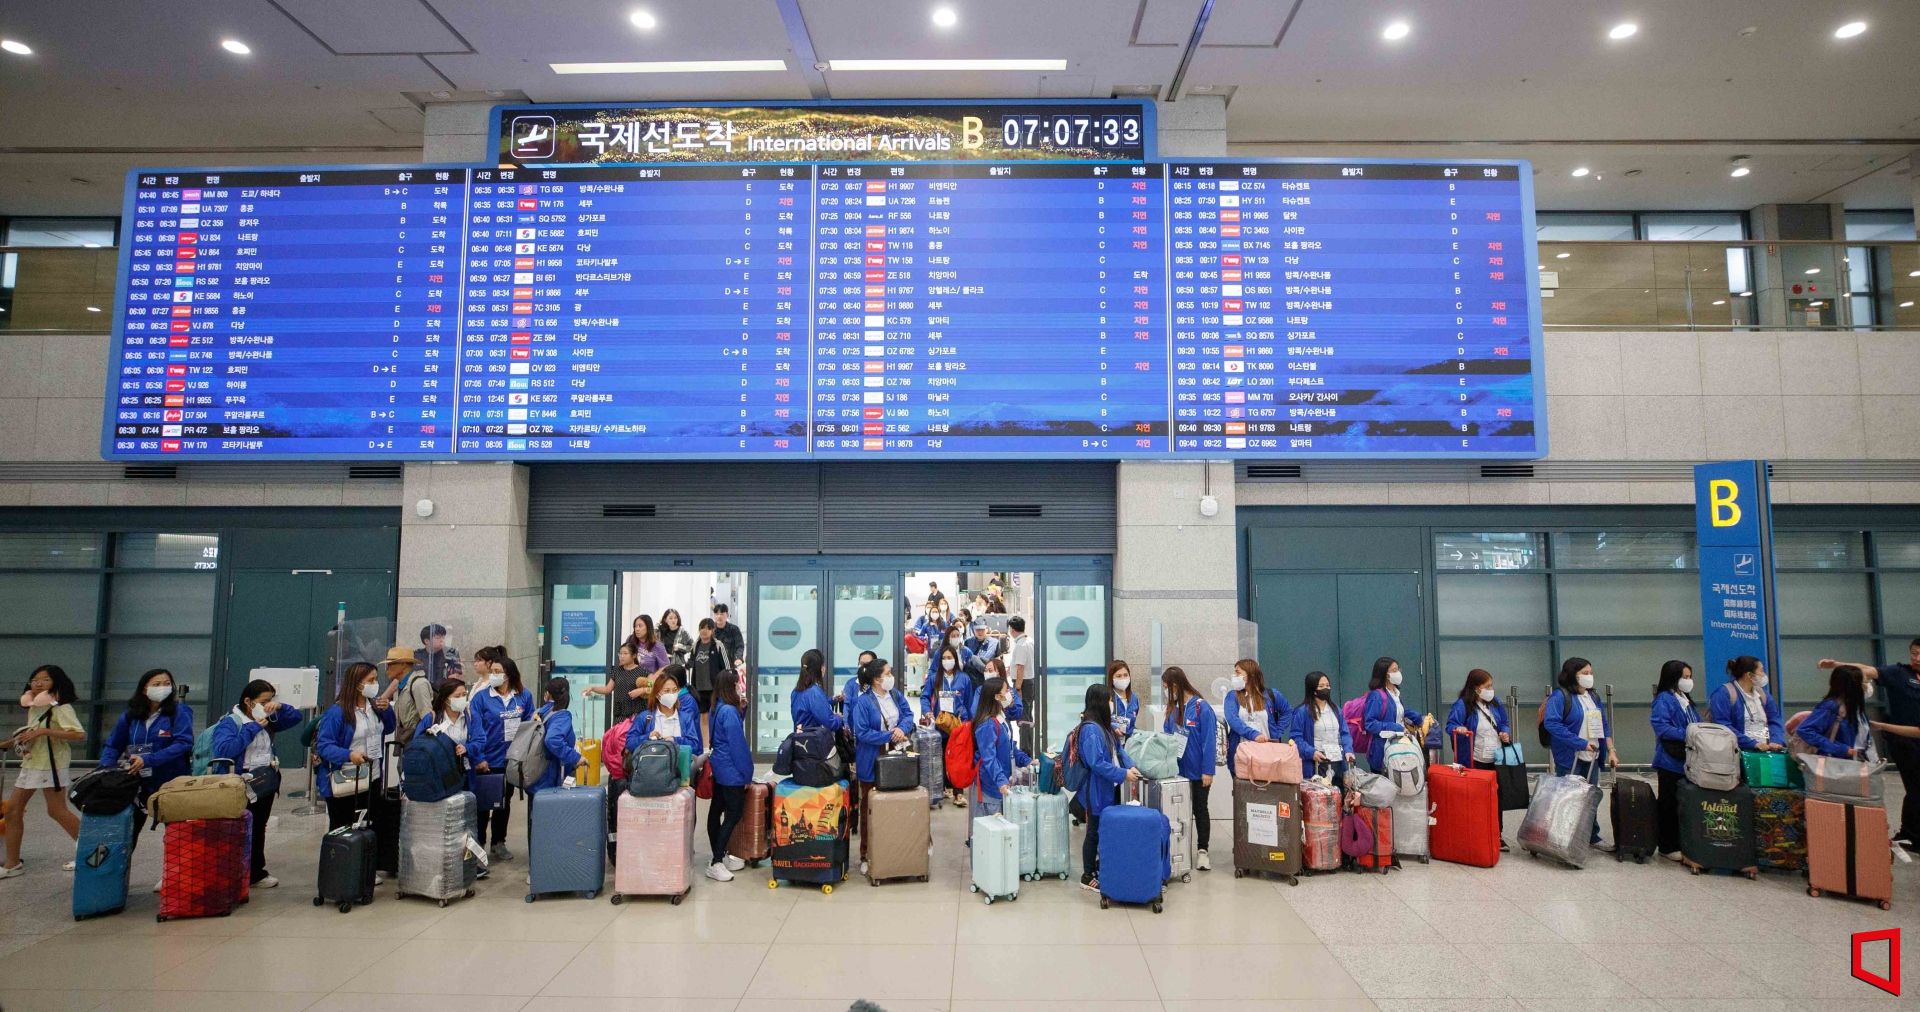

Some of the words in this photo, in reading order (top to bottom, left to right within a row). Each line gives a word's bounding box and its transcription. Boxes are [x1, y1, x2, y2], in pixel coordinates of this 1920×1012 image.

[577, 121, 736, 153] 국제선도착
[747, 134, 872, 152] International
[878, 134, 951, 152] Arrivals
[962, 116, 984, 150] B
[1004, 118, 1139, 146] 07:07:33
[476, 171, 492, 180] 시간
[542, 170, 557, 179] 편명
[639, 169, 661, 178] 출발지
[741, 168, 757, 177] 출구
[779, 168, 795, 177] 현황
[822, 167, 838, 176] 시간
[890, 167, 905, 176] 편명
[989, 166, 1011, 176] 출발지
[1093, 166, 1108, 176] 출구
[1131, 166, 1147, 176] 현황
[1174, 166, 1190, 176] 시간
[1242, 167, 1257, 176] 편명
[1341, 167, 1364, 176] 출발지
[1443, 168, 1459, 177] 출구
[1483, 168, 1498, 178] 현황
[142, 176, 157, 185] 시간
[206, 175, 220, 185] 편명
[299, 174, 321, 183] 출발지
[398, 172, 413, 182] 출구
[435, 172, 450, 181] 현황
[778, 182, 794, 191] 도착
[928, 182, 958, 191] 비엔티안
[1131, 181, 1147, 190] 지연
[1281, 182, 1310, 191] 타슈켄트
[260, 189, 281, 198] 하네다
[434, 186, 449, 195] 도착
[578, 199, 593, 208] 세부
[778, 197, 794, 206] 지연
[1282, 196, 1311, 206] 타슈켄트
[578, 214, 606, 223] 싱가포르
[928, 211, 951, 220] 나트랑
[1486, 212, 1501, 221] 지연
[928, 226, 950, 235] 하노이
[1283, 226, 1306, 235] 사이판
[237, 233, 259, 242] 나트랑
[576, 243, 592, 252] 다낭
[576, 258, 618, 267] 코타키나발루
[928, 256, 951, 265] 나트랑
[1284, 256, 1300, 265] 다낭
[235, 262, 263, 271] 치앙마이
[928, 270, 957, 280] 치앙마이
[1133, 270, 1149, 280] 도착
[232, 291, 254, 300] 하노이
[574, 288, 590, 297] 세부
[426, 304, 442, 313] 지연
[927, 301, 943, 310] 세부
[1491, 301, 1506, 310] 지연
[927, 316, 950, 325] 알마티
[1286, 316, 1309, 325] 나트랑
[230, 321, 246, 330] 다낭
[572, 333, 588, 342] 다낭
[776, 332, 791, 341] 지연
[927, 331, 943, 340] 세부
[1286, 331, 1316, 340] 싱가포르
[572, 348, 594, 357] 사이판
[927, 346, 957, 356] 싱가포르
[571, 363, 601, 373] 비엔티안
[571, 378, 586, 388] 다낭
[927, 377, 957, 387] 치앙마이
[1288, 377, 1325, 386] 부다페스트
[1288, 392, 1315, 402] 오사카/
[1316, 392, 1338, 402] 간사이
[927, 408, 950, 417] 하노이
[1497, 408, 1512, 417] 지연
[420, 424, 436, 434] 지연
[569, 424, 602, 434] 자카르타/
[603, 424, 647, 433] 수카르노하타
[927, 423, 950, 433] 나트랑
[1135, 423, 1151, 433] 지연
[1289, 423, 1312, 433] 나트랑
[221, 440, 264, 450] 코타키나발루
[569, 439, 591, 449] 나트랑
[927, 439, 943, 448] 다낭
[1290, 438, 1312, 448] 알마티
[1709, 478, 1742, 528] B
[1712, 583, 1756, 596] 국제선도착
[1710, 620, 1758, 631] International
[1730, 630, 1759, 640] Arrivals
[1700, 800, 1738, 813] Island
